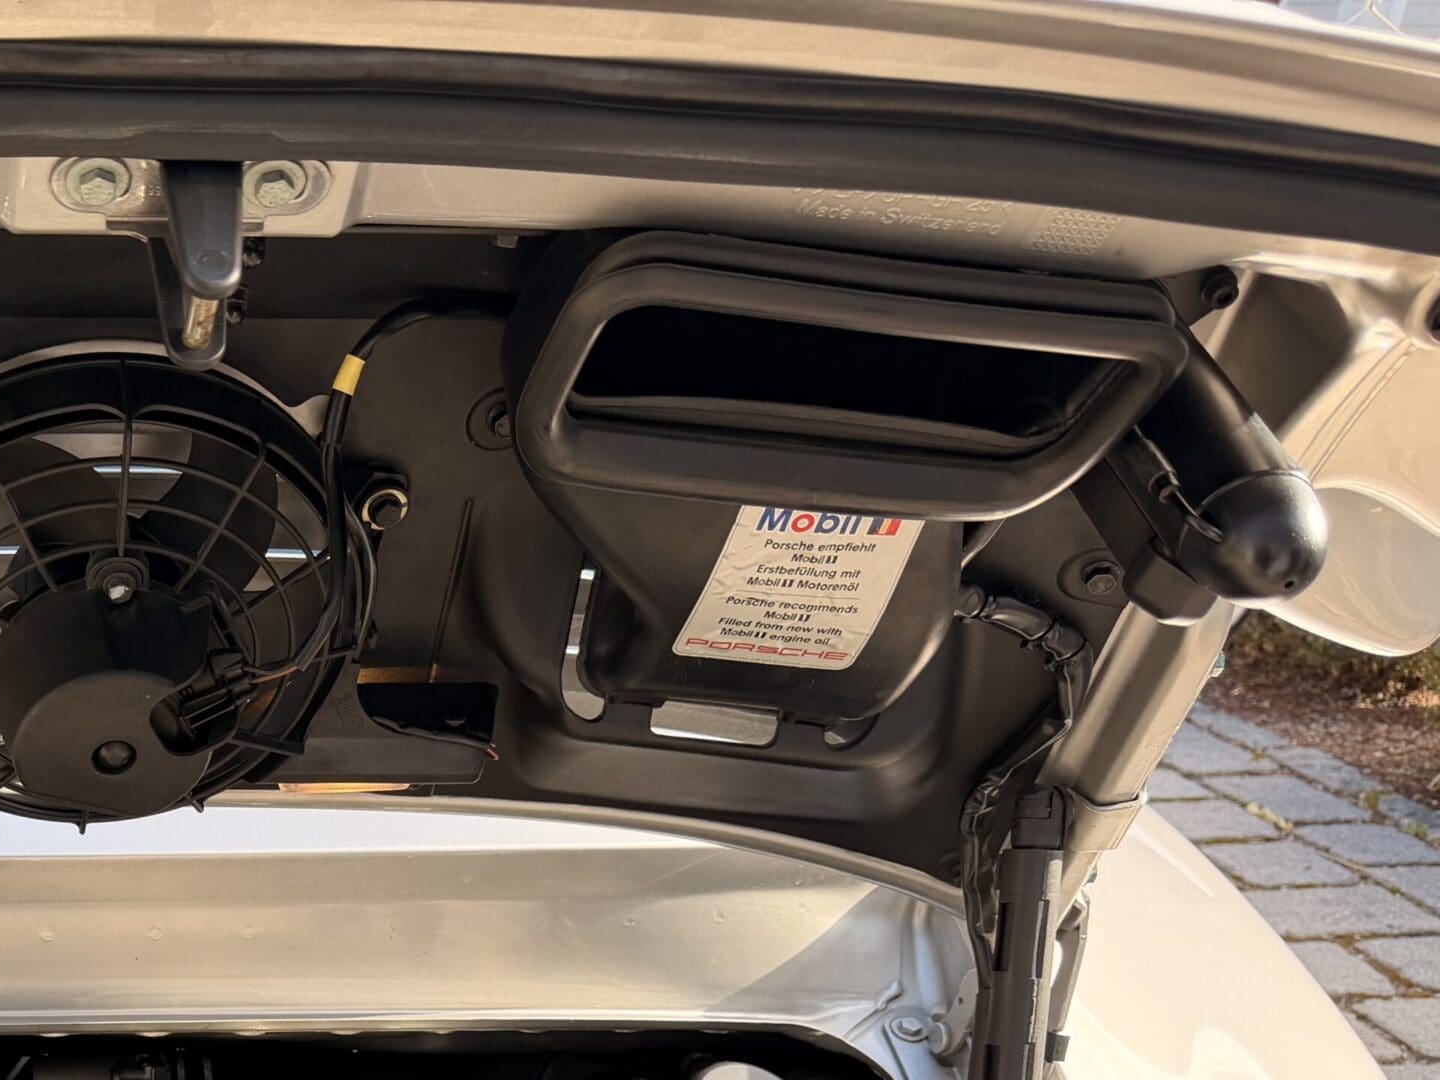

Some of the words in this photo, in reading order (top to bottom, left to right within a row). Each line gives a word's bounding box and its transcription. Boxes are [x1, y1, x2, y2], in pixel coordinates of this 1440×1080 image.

[756, 506, 863, 535] Mobil
[764, 538, 814, 551] Porsche
[817, 542, 877, 553] empfiehlt
[790, 553, 825, 564] Mobil
[756, 564, 838, 579] Erstbefüllung
[840, 568, 861, 579] mit
[746, 576, 781, 588] Mobil
[796, 580, 860, 592] Motorenöl
[725, 596, 775, 608] Porsche
[778, 600, 859, 614] recommends
[763, 610, 797, 621] Mobil
[717, 617, 751, 628] Filled
[754, 621, 783, 631] from
[786, 625, 814, 634] new
[816, 627, 843, 637] with
[719, 627, 753, 638] Mobil
[769, 633, 811, 645] engine
[684, 637, 849, 661] PORSCHE
